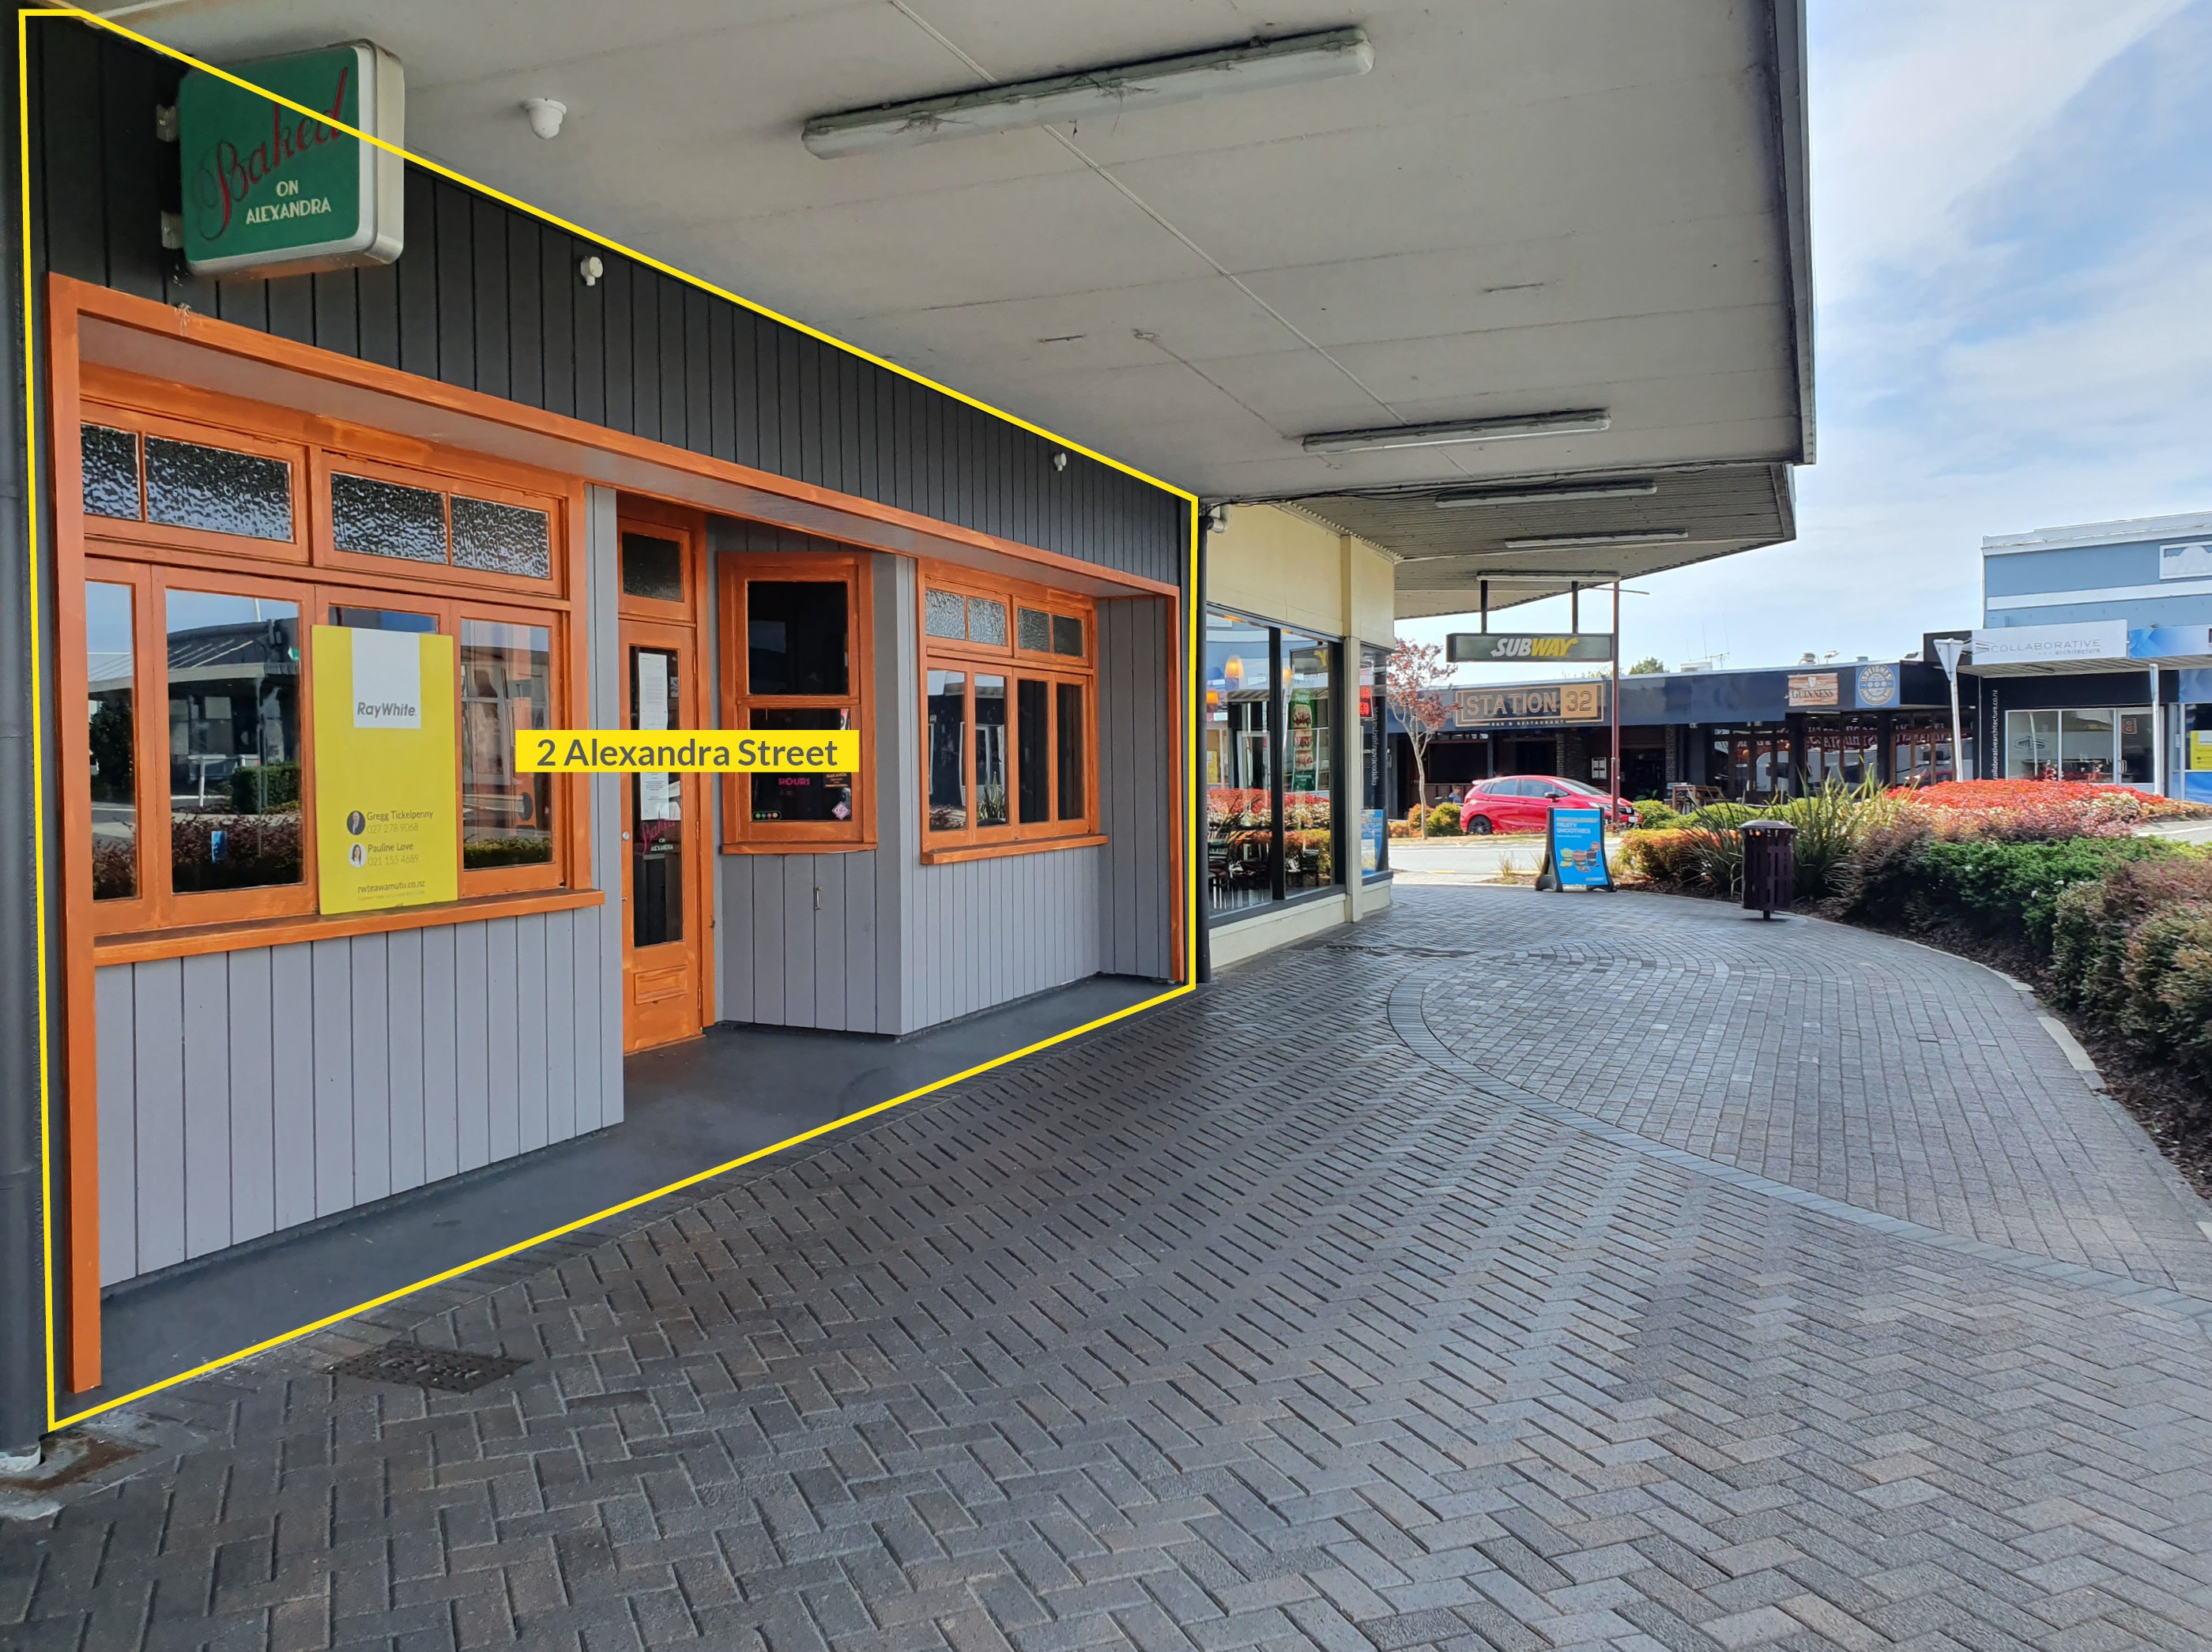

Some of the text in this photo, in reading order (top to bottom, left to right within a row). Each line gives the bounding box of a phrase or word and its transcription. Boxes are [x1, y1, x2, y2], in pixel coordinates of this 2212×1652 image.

[192, 66, 348, 240] Baked
[276, 179, 299, 197] ON
[245, 198, 332, 225] ALEXANDRA
[1490, 638, 1579, 657] SUBWAY
[1991, 638, 2101, 653] COLLABORATIVE
[1792, 689, 1833, 699] GUINNESS
[1466, 690, 1592, 716] STATION 32
[367, 810, 433, 822] Gregg Tickelpenny
[367, 824, 382, 834] 027
[384, 823, 398, 833] 278
[367, 841, 413, 853] Pauline Love
[367, 856, 382, 867] 021
[357, 880, 425, 894] rwteawamutu.co.nz
